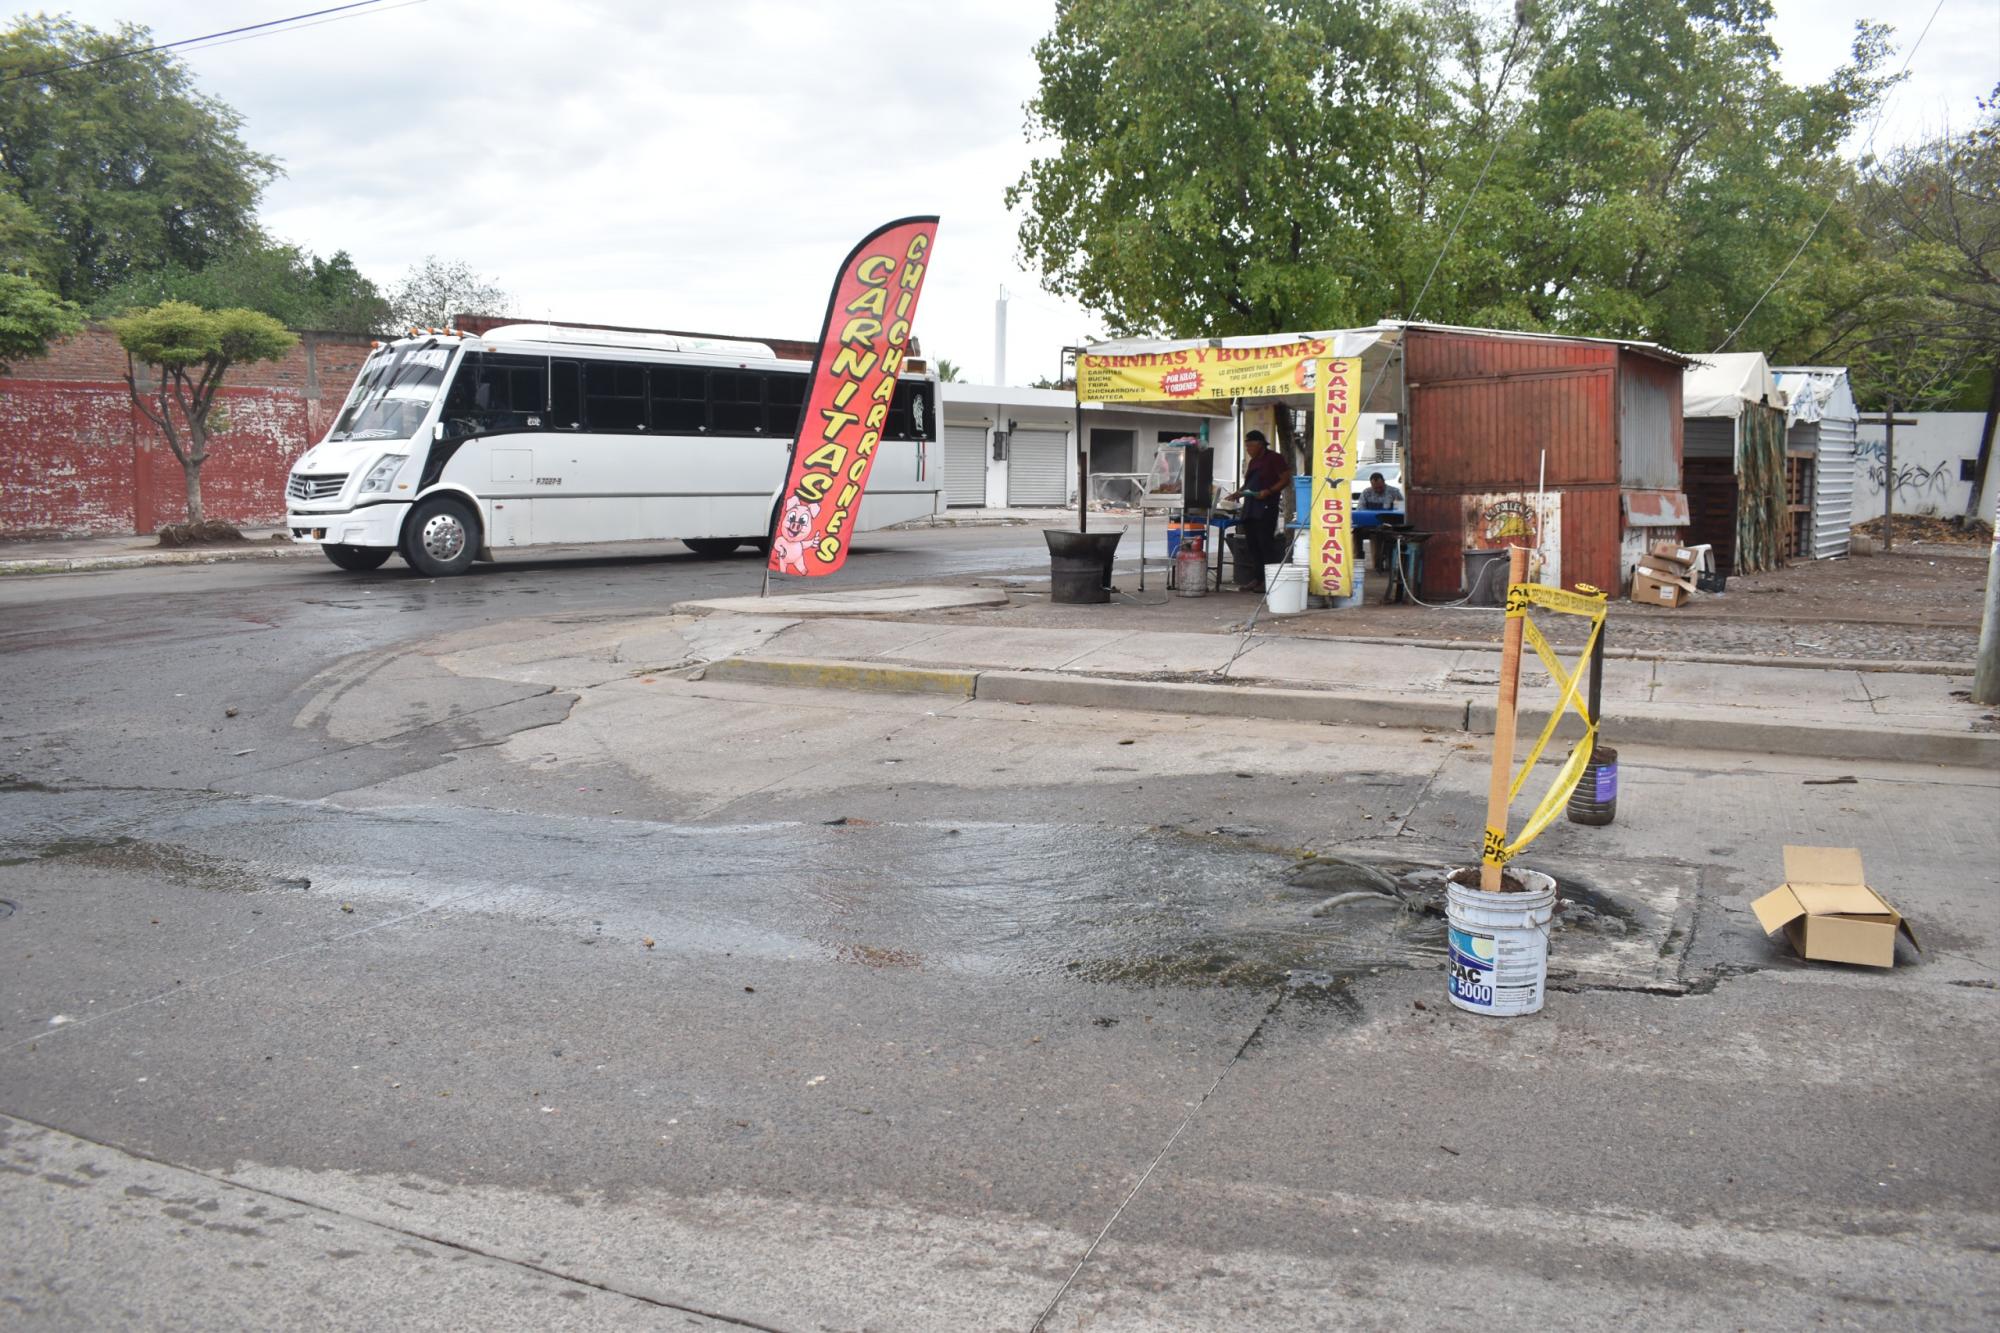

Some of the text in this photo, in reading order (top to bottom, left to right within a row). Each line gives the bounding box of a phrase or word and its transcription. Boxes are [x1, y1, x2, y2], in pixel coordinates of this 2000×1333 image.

[1084, 339, 1327, 368] CARNITAS Y BOTANAS
[793, 255, 896, 504] CARNITAS
[1164, 381, 1198, 394] Y ORDENES
[1166, 371, 1197, 384] POR KILOS
[815, 233, 929, 564] CHICHARRONES
[1230, 386, 1245, 396] 667
[1324, 361, 1348, 469] CARNITAS
[1325, 477, 1345, 490] Y
[1322, 499, 1344, 592] BOTANAS
[1458, 979, 1491, 1002] 5000
